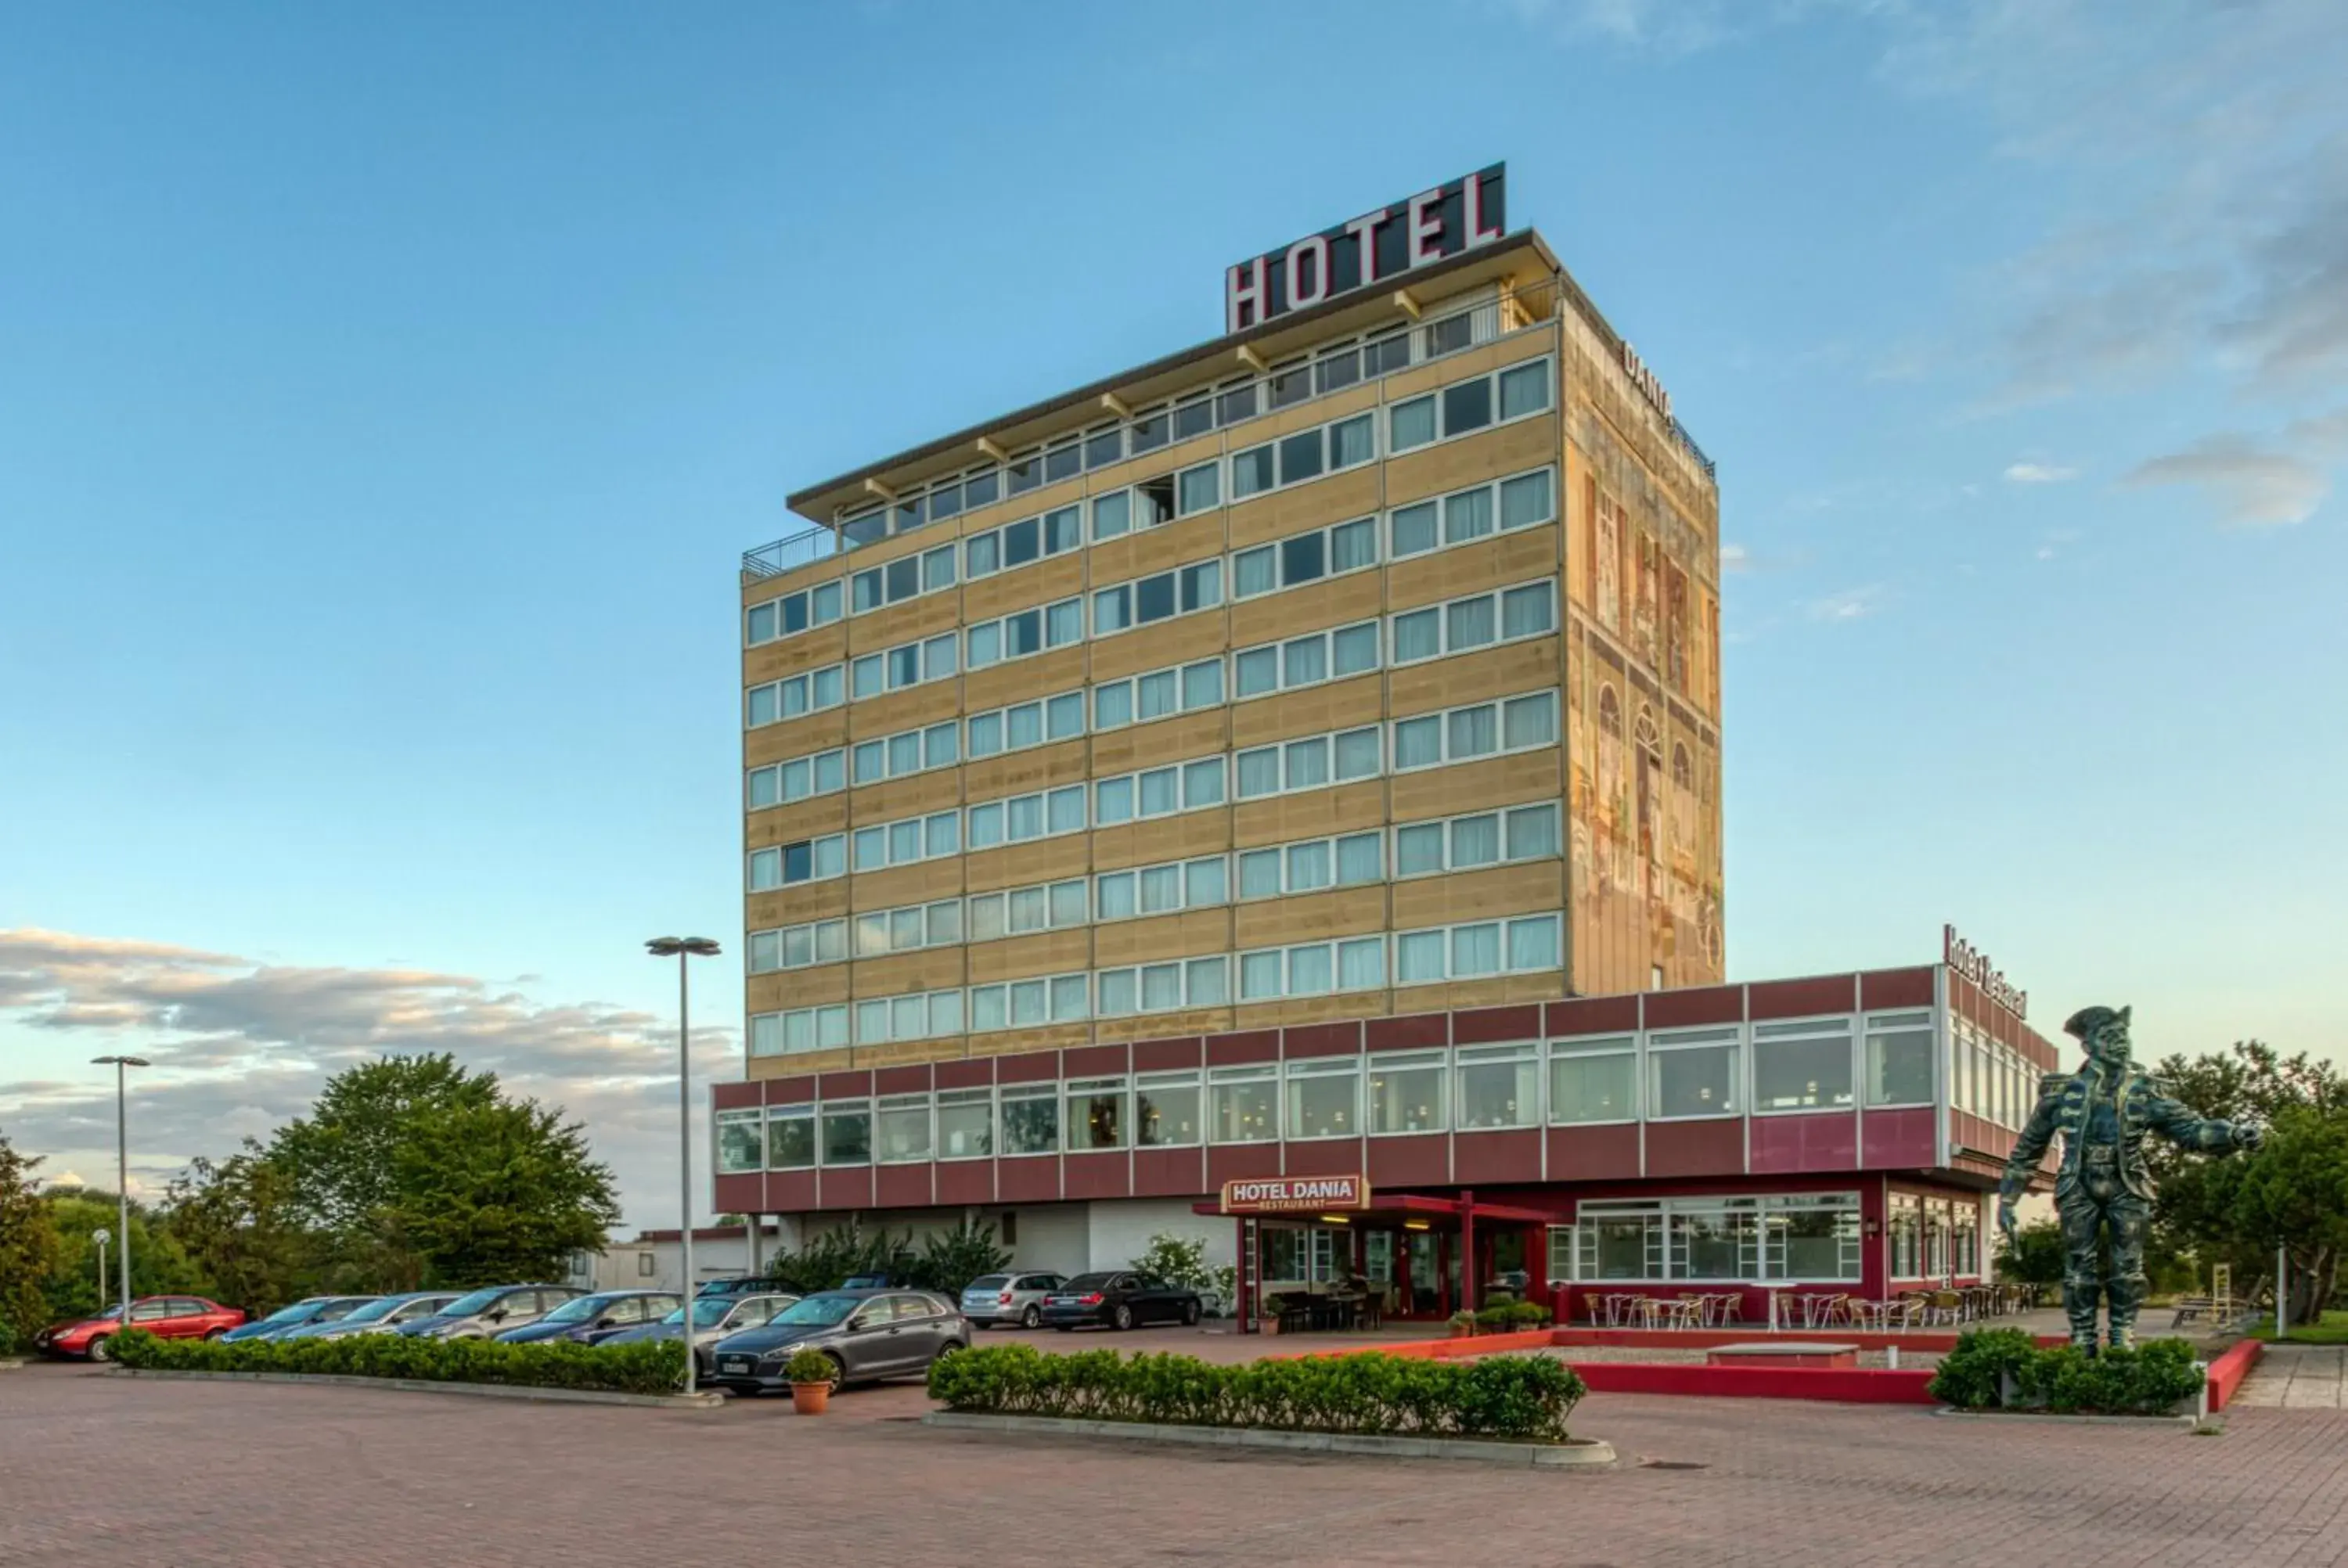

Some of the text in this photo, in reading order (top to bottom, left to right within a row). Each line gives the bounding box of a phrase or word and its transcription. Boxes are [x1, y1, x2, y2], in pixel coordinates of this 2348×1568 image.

[1226, 174, 1502, 335] HOTEL
[1233, 1180, 1352, 1201] HOTEL DANIA
[1259, 1199, 1326, 1210] RESTAURANT
